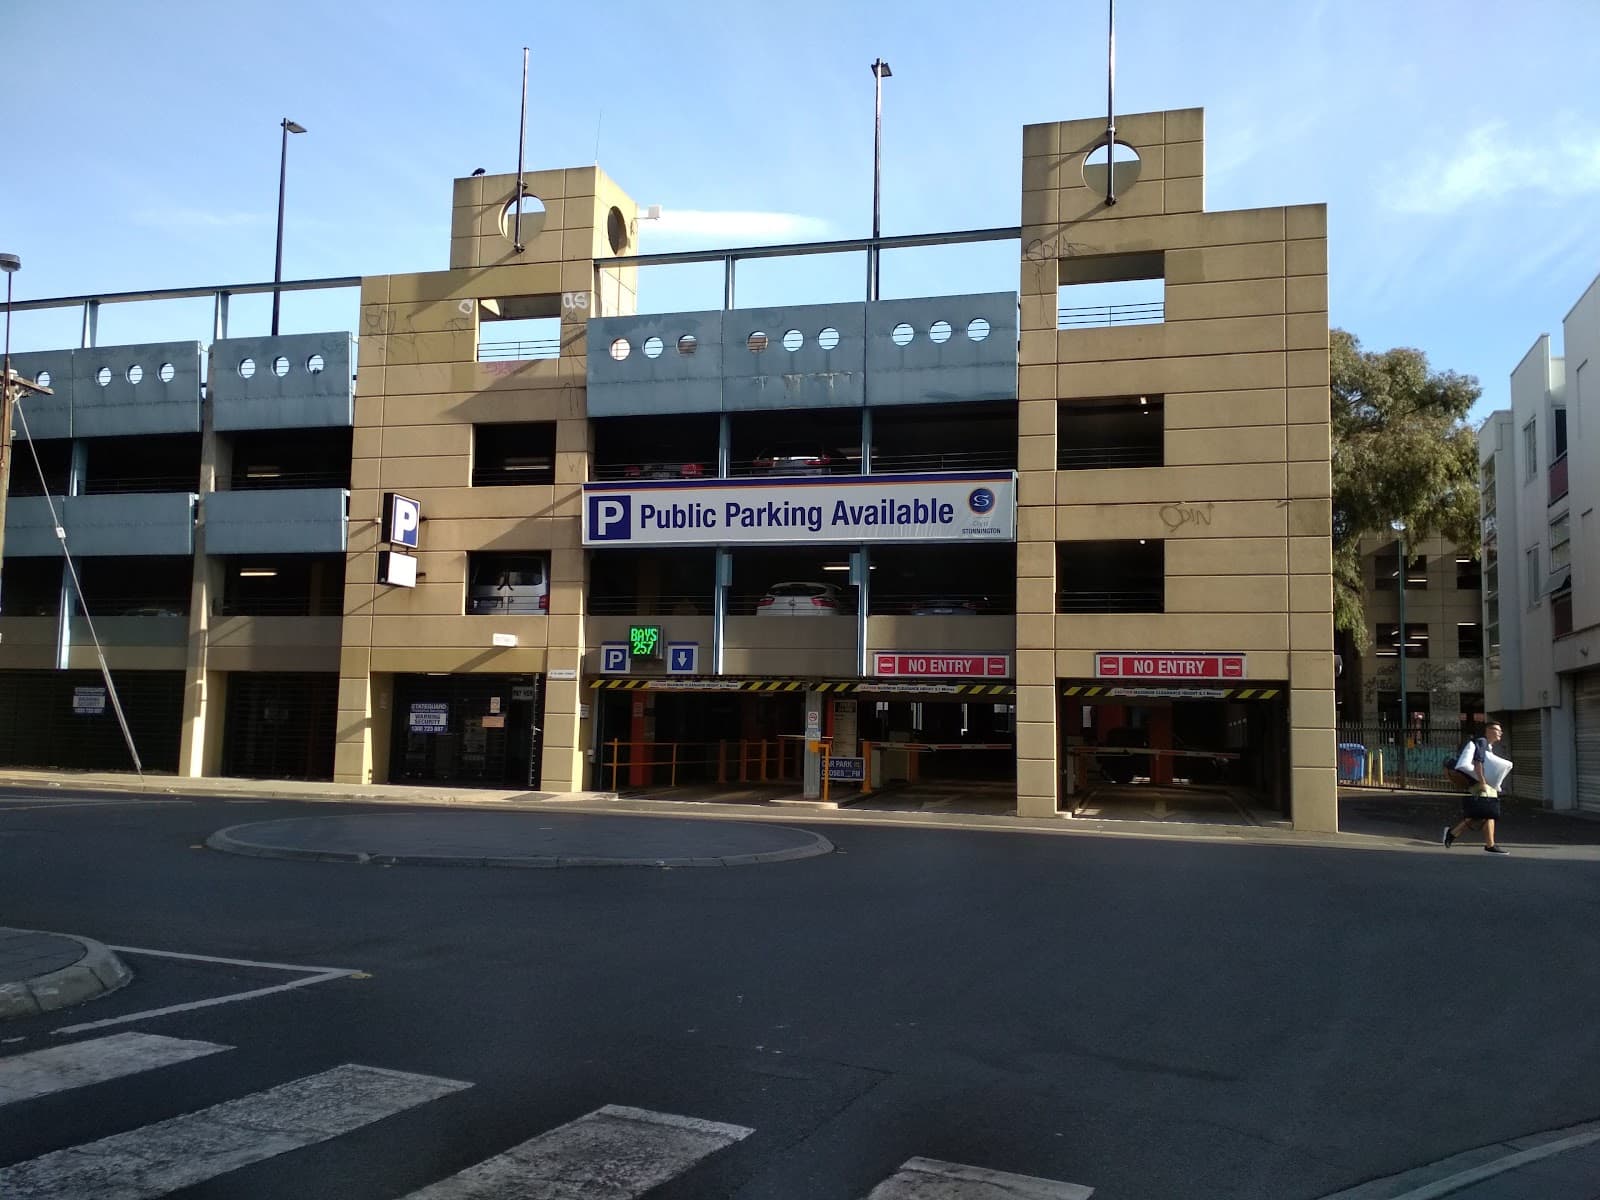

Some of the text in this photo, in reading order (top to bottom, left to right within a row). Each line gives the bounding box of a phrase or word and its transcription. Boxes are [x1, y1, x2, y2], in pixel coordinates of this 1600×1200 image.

[394, 498, 417, 542] P
[597, 498, 954, 536] P Public Parking Available
[630, 628, 658, 642] BAYS
[632, 641, 654, 655] 257
[608, 650, 623, 669] P
[908, 659, 972, 673] NO ENTRY
[1133, 660, 1205, 674] NO ENTRY
[821, 760, 835, 768] CR
[835, 760, 853, 768] PARK
